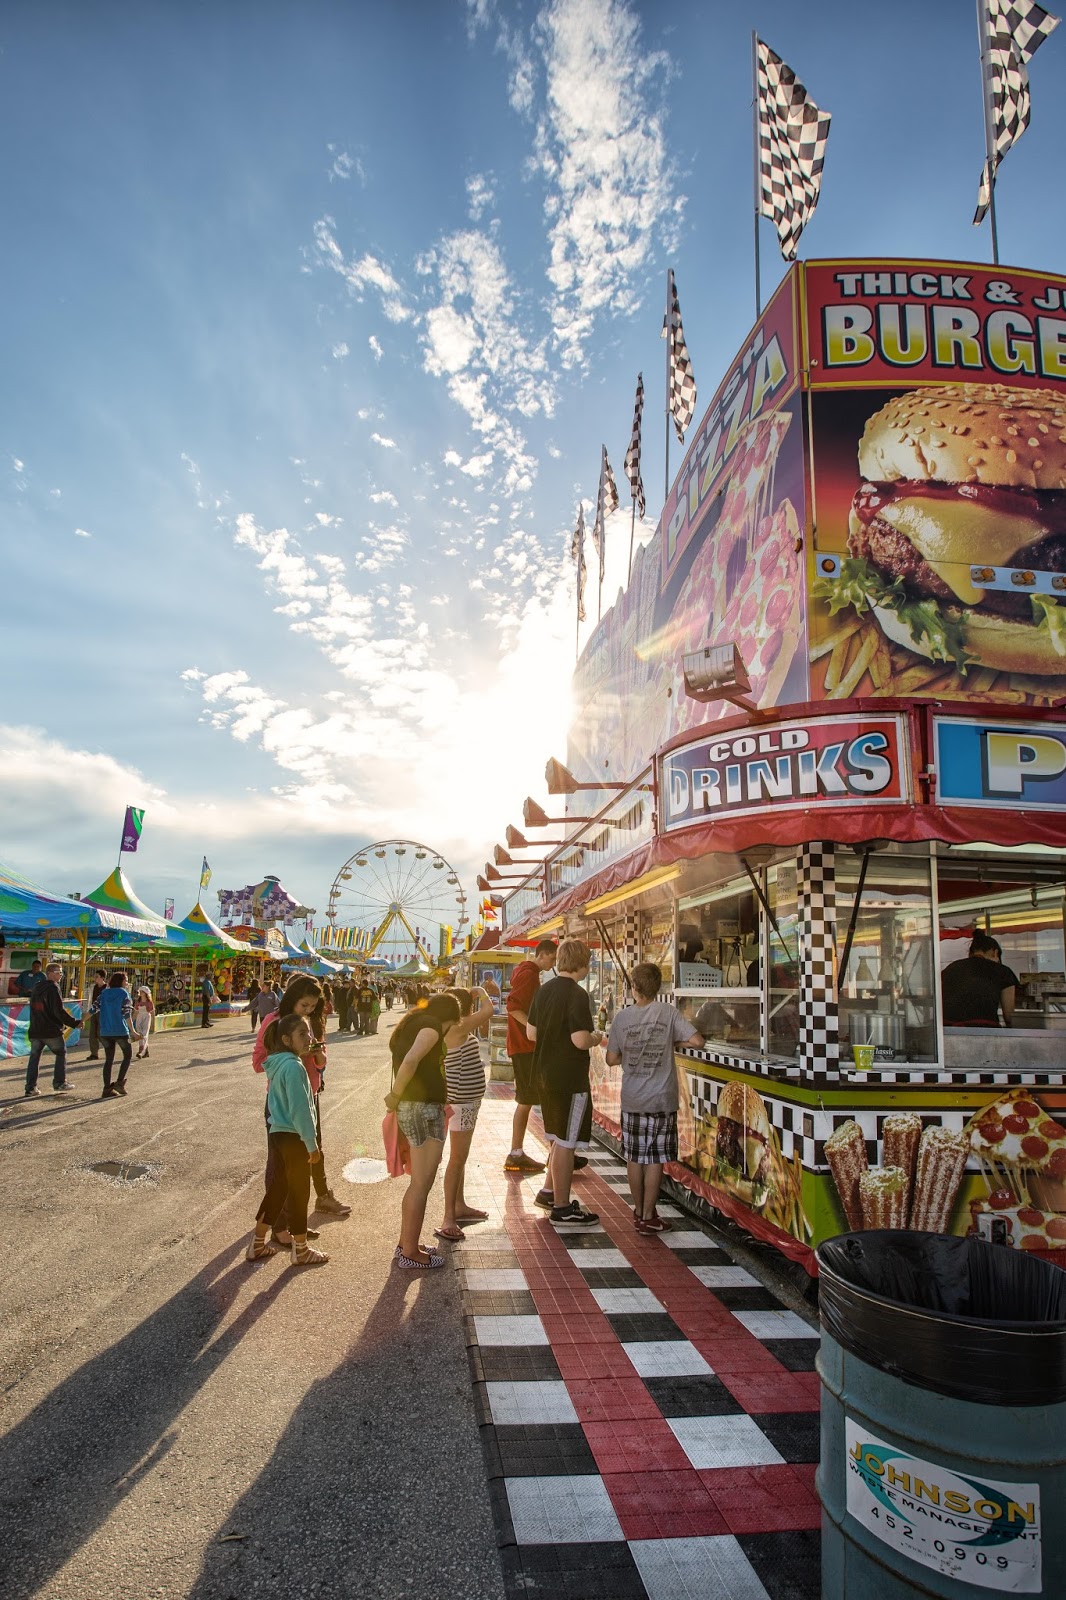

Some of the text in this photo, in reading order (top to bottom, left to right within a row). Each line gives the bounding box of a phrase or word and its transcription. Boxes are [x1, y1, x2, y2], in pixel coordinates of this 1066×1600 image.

[835, 272, 973, 299] THICK
[985, 280, 1020, 305] &
[667, 334, 788, 563] PIZZA
[677, 327, 764, 497] FRESH
[668, 732, 892, 818] DRINKS
[709, 729, 810, 762] COLD
[875, 1047, 894, 1056] lassic
[849, 1441, 1036, 1525] JOHNSON
[849, 1462, 1039, 1541] WASTE MANAGEMENT
